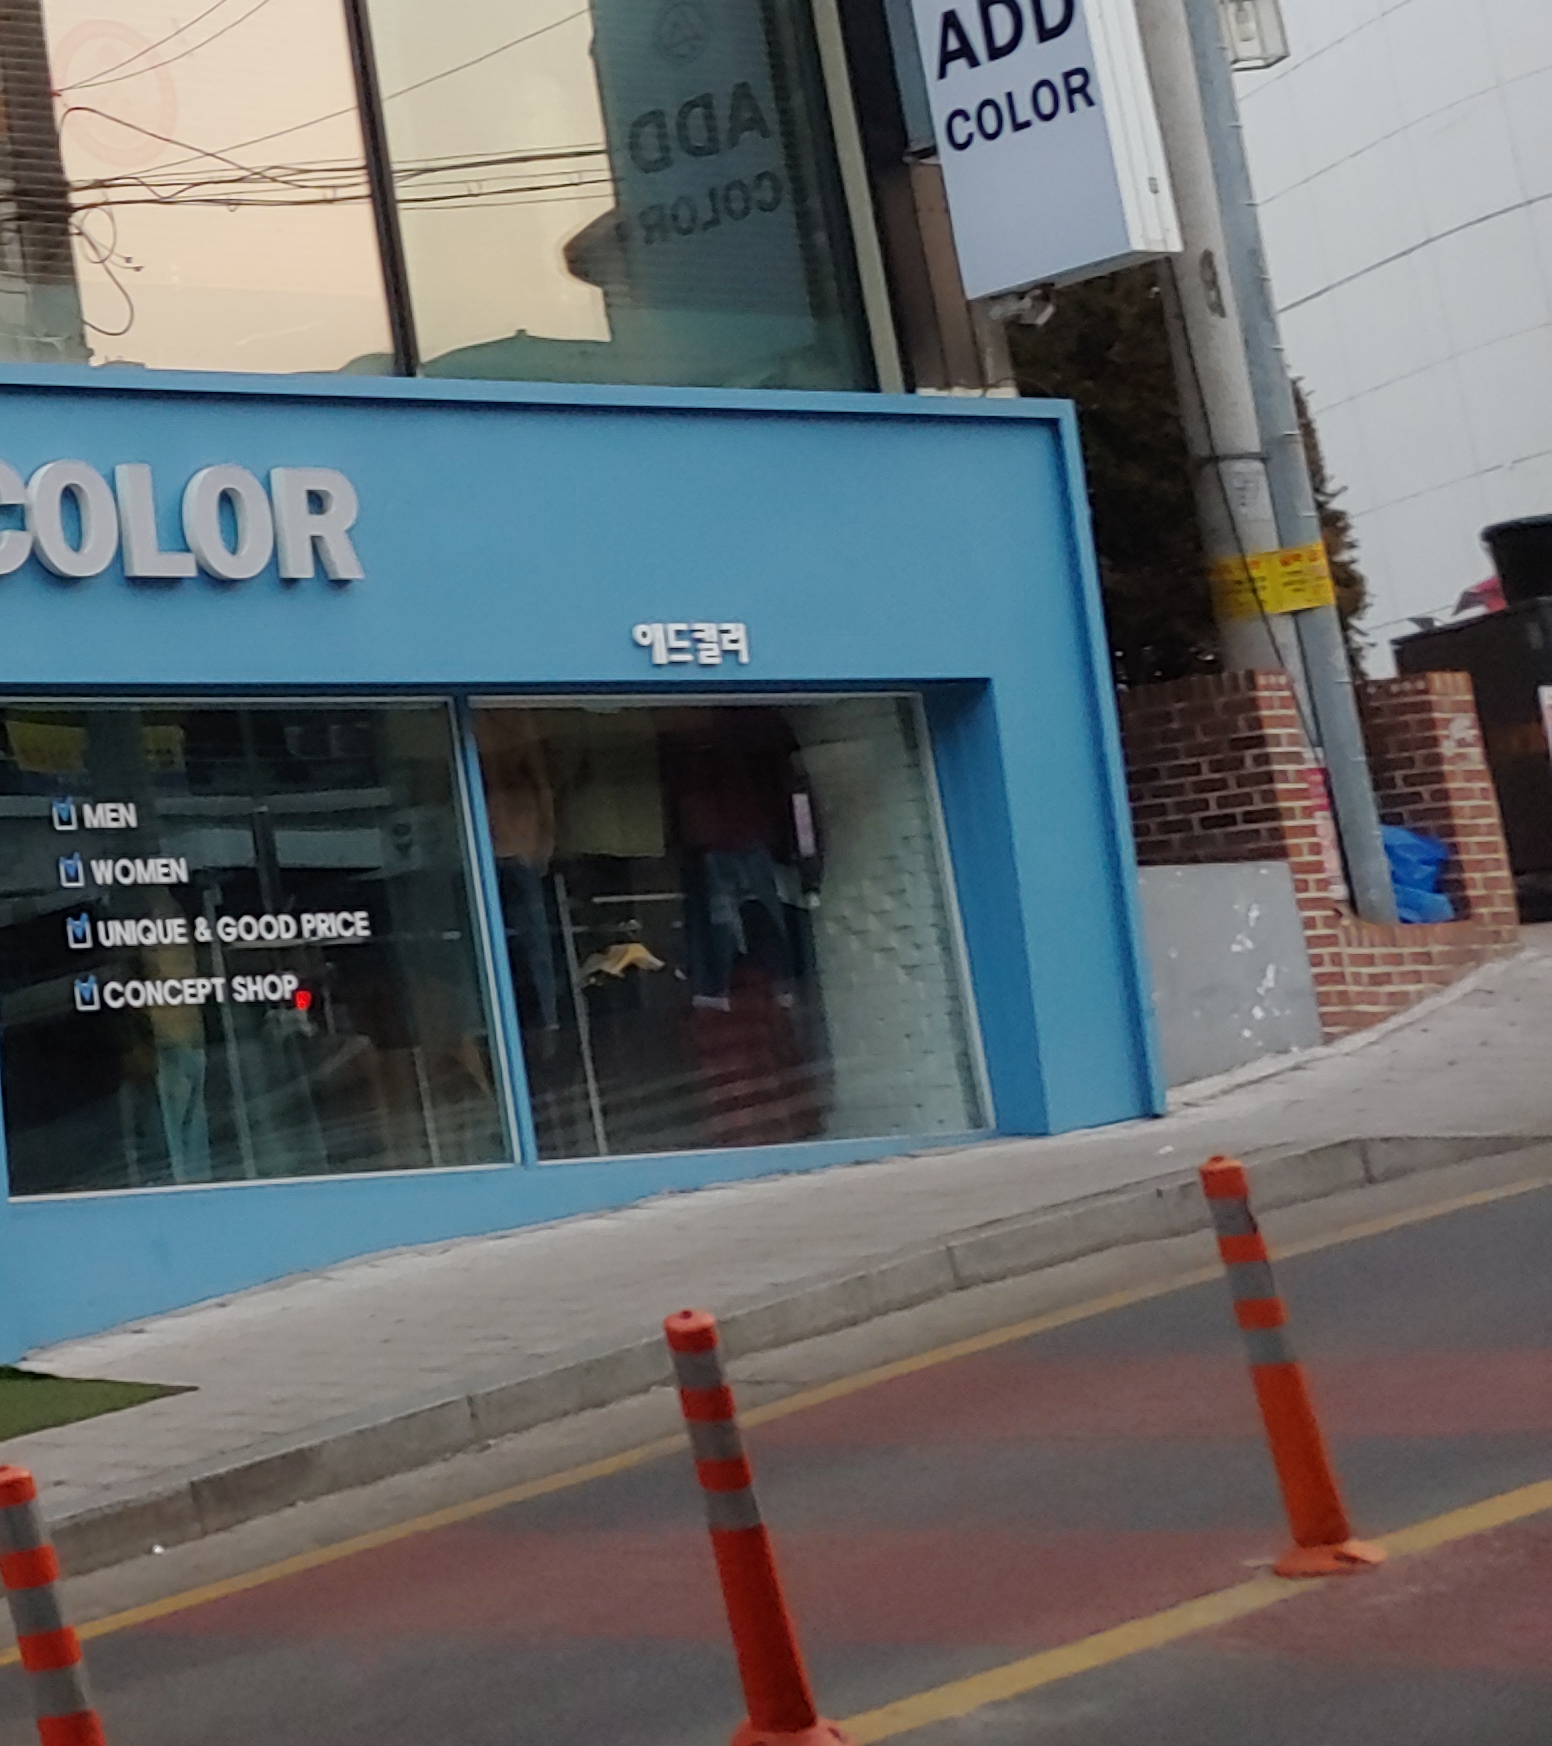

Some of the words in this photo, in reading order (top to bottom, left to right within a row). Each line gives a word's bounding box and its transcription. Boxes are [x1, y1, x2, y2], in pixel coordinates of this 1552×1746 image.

[946, 66, 1095, 152] COLOR
[83, 803, 138, 828] MEN
[90, 857, 189, 885] WOMEN
[97, 919, 189, 946] UNIQUE
[194, 917, 213, 942] &
[216, 914, 297, 941] GOOD
[300, 911, 371, 938] PRICE
[103, 977, 225, 1008] CONCEPT
[232, 974, 299, 1003] SHOP
